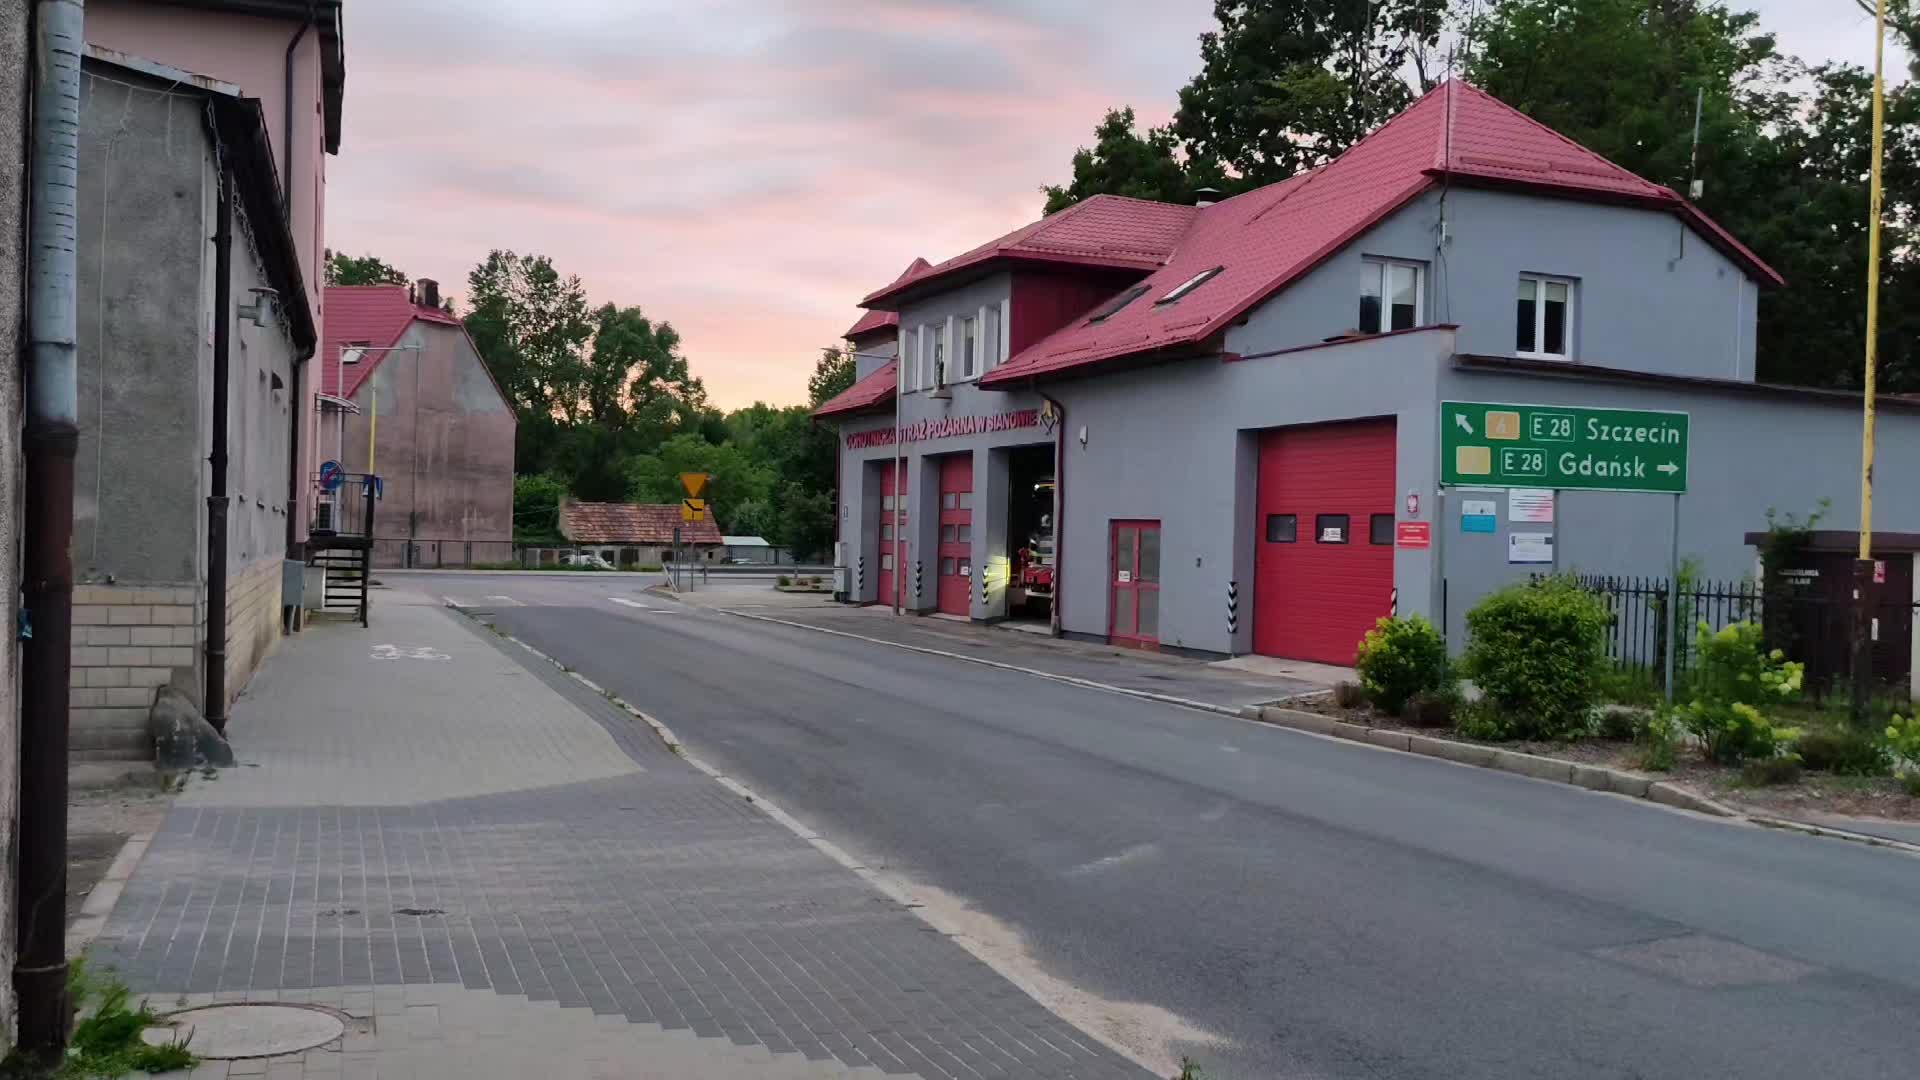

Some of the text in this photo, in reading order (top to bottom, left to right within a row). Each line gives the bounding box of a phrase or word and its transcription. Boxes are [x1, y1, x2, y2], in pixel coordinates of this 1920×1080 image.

[928, 414, 976, 439] POŻARNA
[975, 415, 986, 433] W
[1534, 418, 1543, 435] E
[1550, 419, 1571, 437] 28
[1586, 418, 1680, 444] Szczecin
[1505, 452, 1646, 478] E 28 Gdańsk
